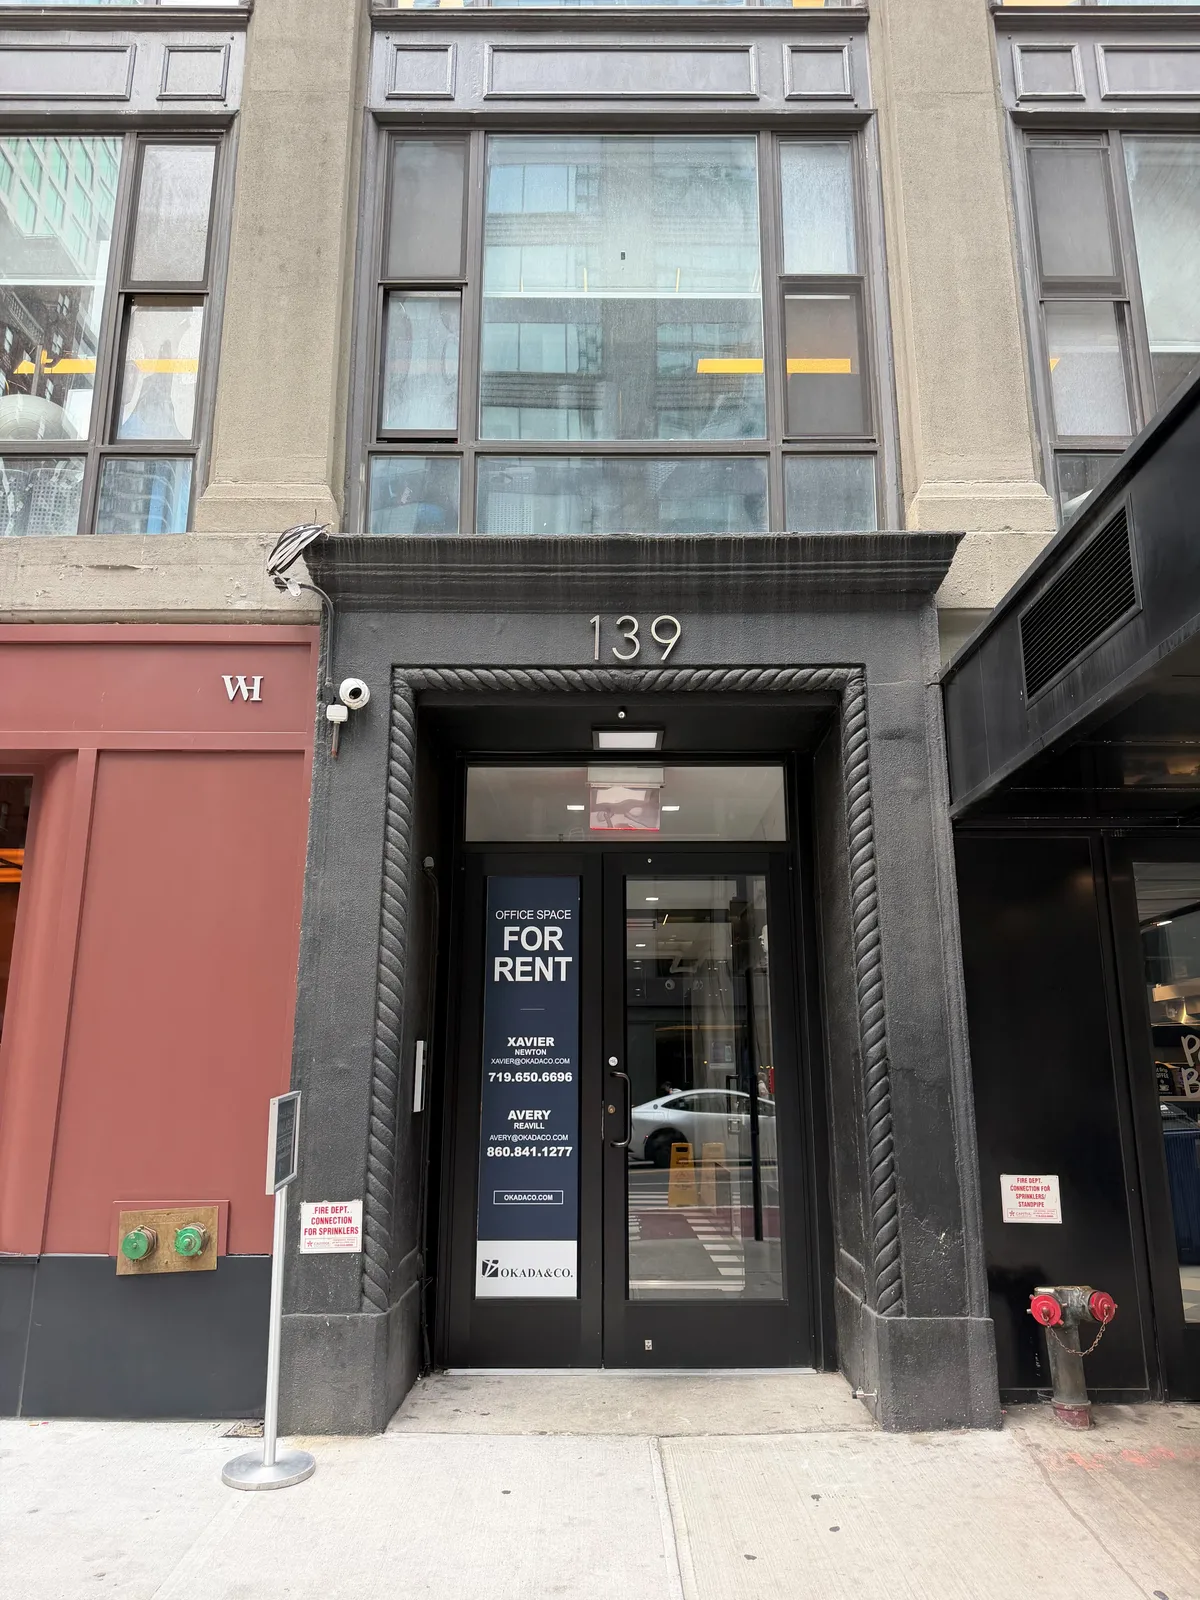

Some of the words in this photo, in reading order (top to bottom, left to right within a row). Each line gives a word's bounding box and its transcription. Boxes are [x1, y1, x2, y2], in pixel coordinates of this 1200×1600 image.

[590, 615, 681, 660] 139
[221, 675, 264, 701] WH
[495, 910, 534, 920] OFFICE
[536, 909, 572, 920] SPACE
[503, 926, 564, 951] FOR
[494, 956, 572, 982] RENT
[507, 1036, 555, 1047] XAVIER
[514, 1048, 547, 1056] NEWTON
[490, 1057, 571, 1066] XAVIER@OKADACO.COM
[488, 1072, 573, 1082] 719.650.6696
[507, 1109, 551, 1121] AVERY
[513, 1122, 545, 1130] REAVILL
[489, 1134, 569, 1142] AVERY@OKADACO.COM
[486, 1146, 573, 1157] 860.841.1277
[503, 1194, 554, 1202] OKADACO.COM
[314, 1206, 330, 1215] FIRE
[310, 1216, 353, 1226] CONNECTION
[303, 1227, 318, 1236] FOR
[318, 1226, 359, 1236] SPRINKLERS
[500, 1267, 574, 1279] OKADA&CO.
